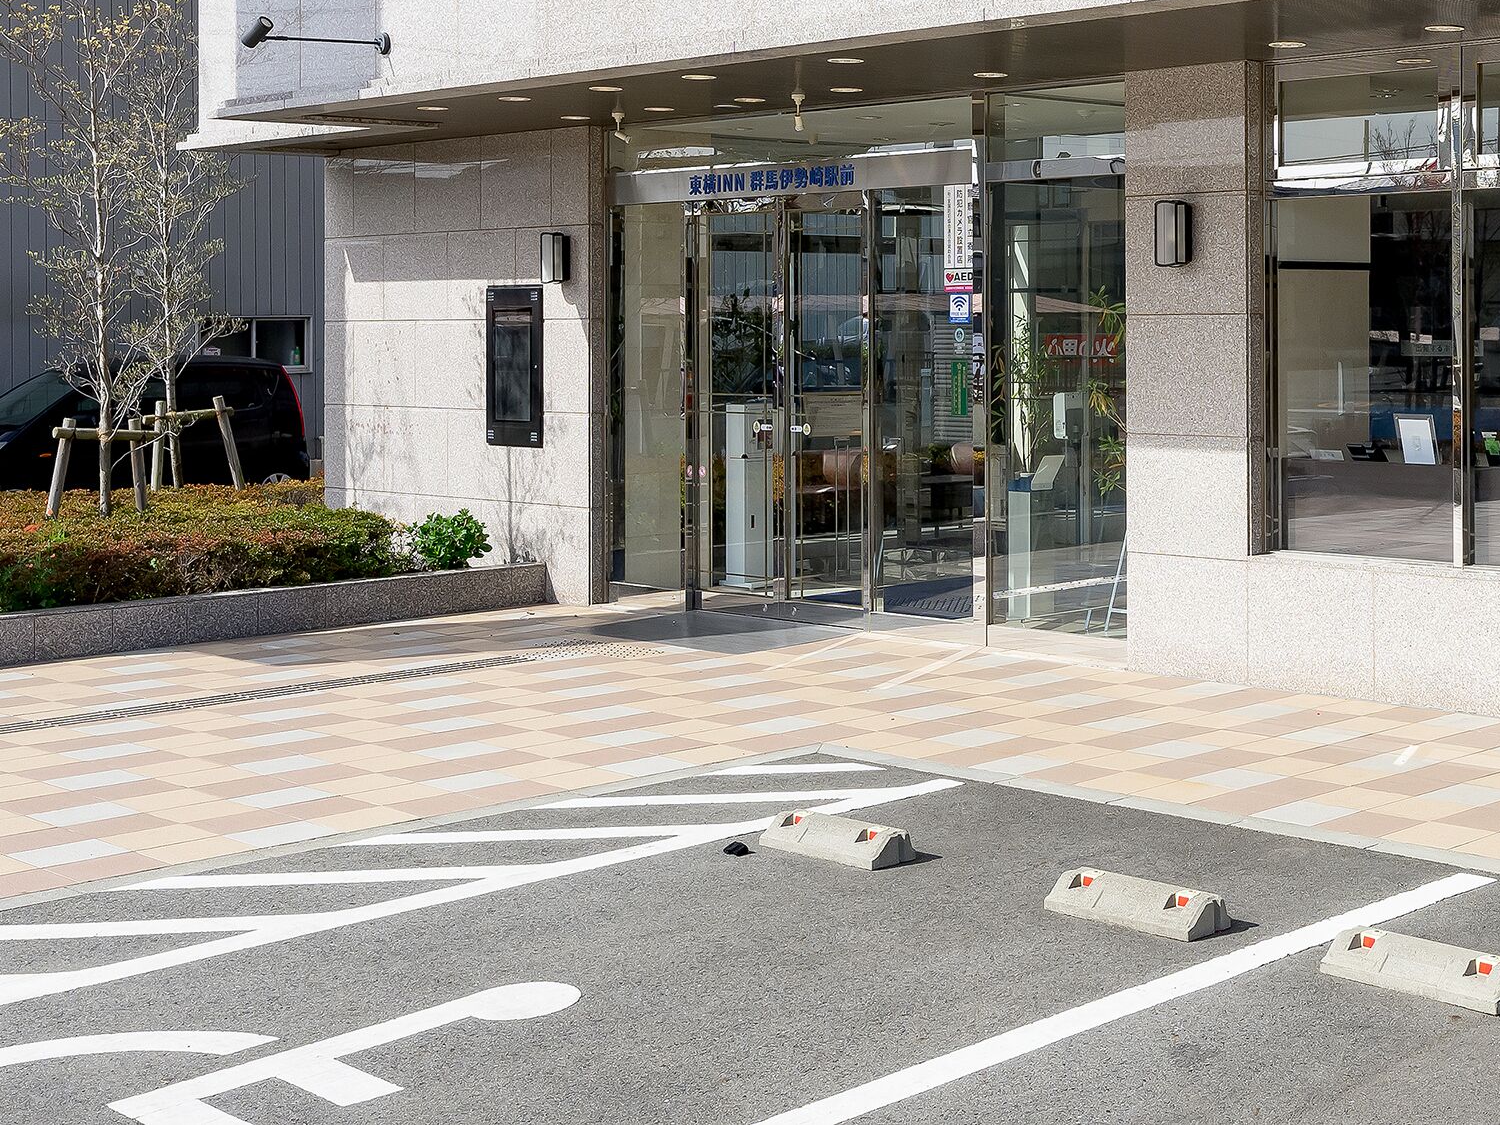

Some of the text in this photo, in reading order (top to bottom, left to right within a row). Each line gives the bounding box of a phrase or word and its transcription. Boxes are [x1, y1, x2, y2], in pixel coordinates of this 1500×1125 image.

[689, 164, 855, 195] 東横INN 群馬伊勢崎駅前
[954, 272, 973, 281] AED
